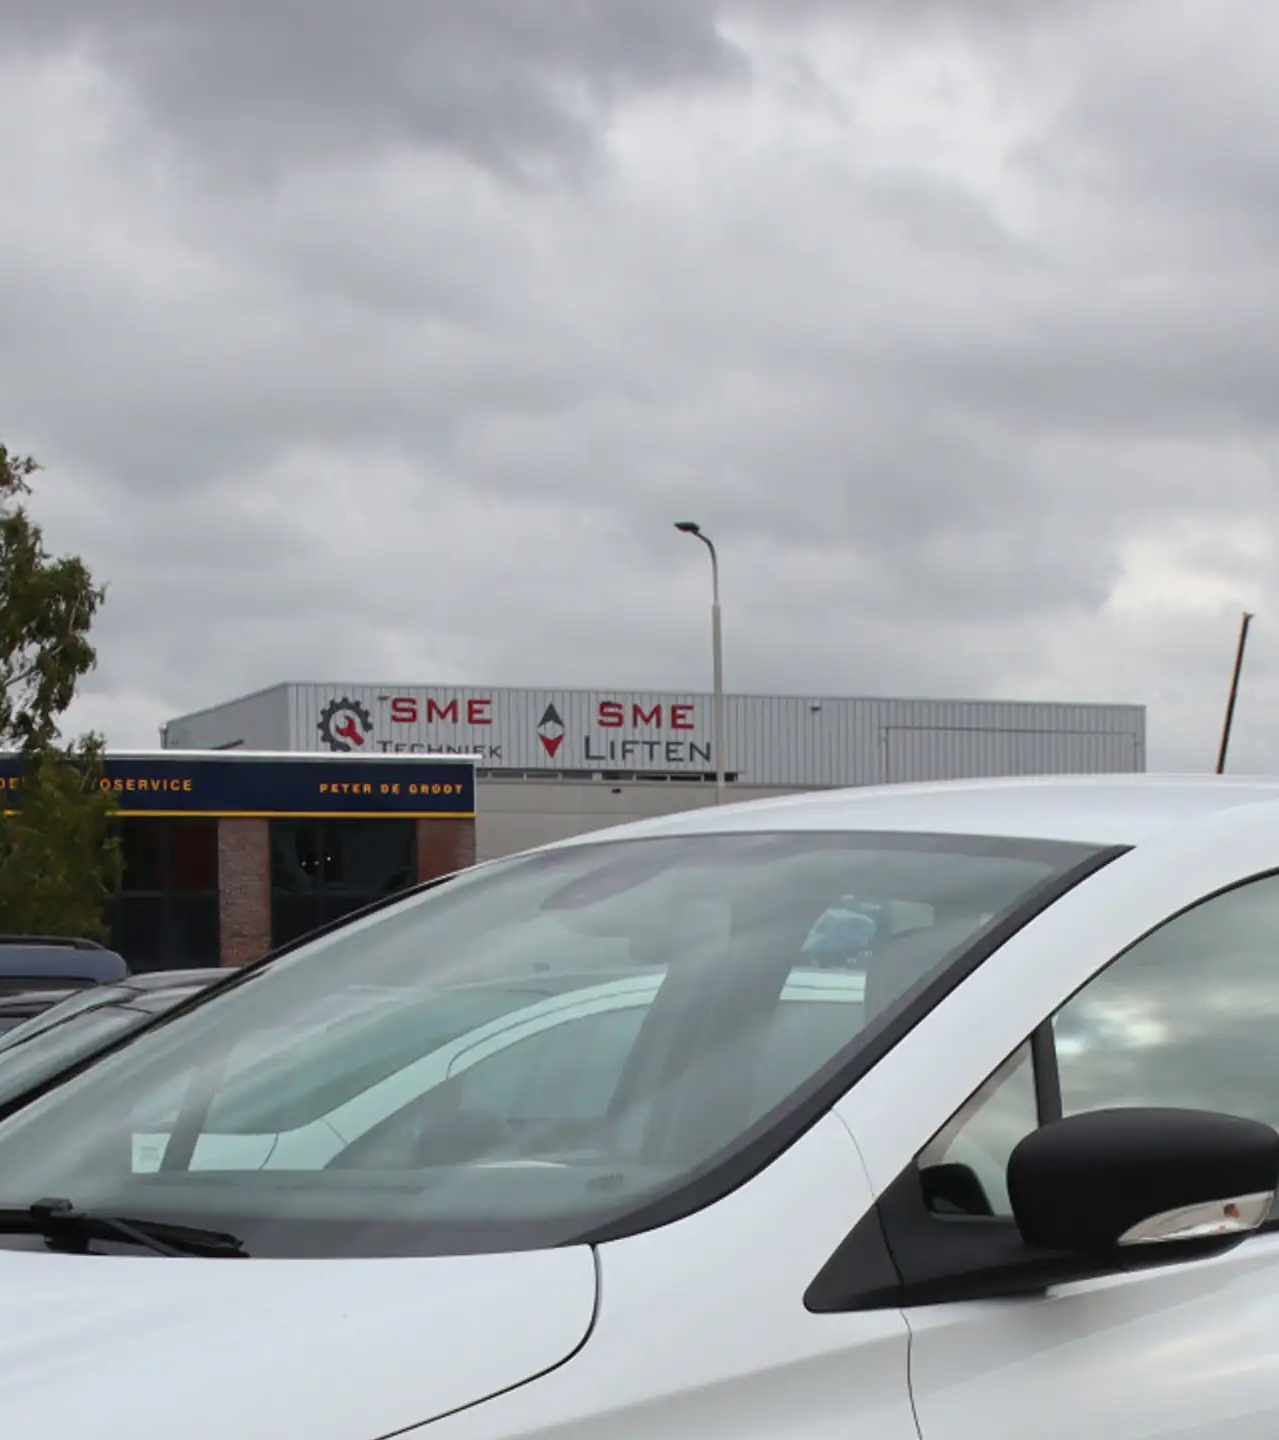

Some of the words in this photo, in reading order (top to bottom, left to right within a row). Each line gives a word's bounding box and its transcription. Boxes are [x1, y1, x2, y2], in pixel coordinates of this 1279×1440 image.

[390, 697, 494, 725] SME
[597, 701, 696, 730] SME
[584, 735, 712, 763] LIFTEN
[319, 783, 372, 794] PETER
[380, 783, 401, 794] DE
[408, 783, 463, 795] GROOT
